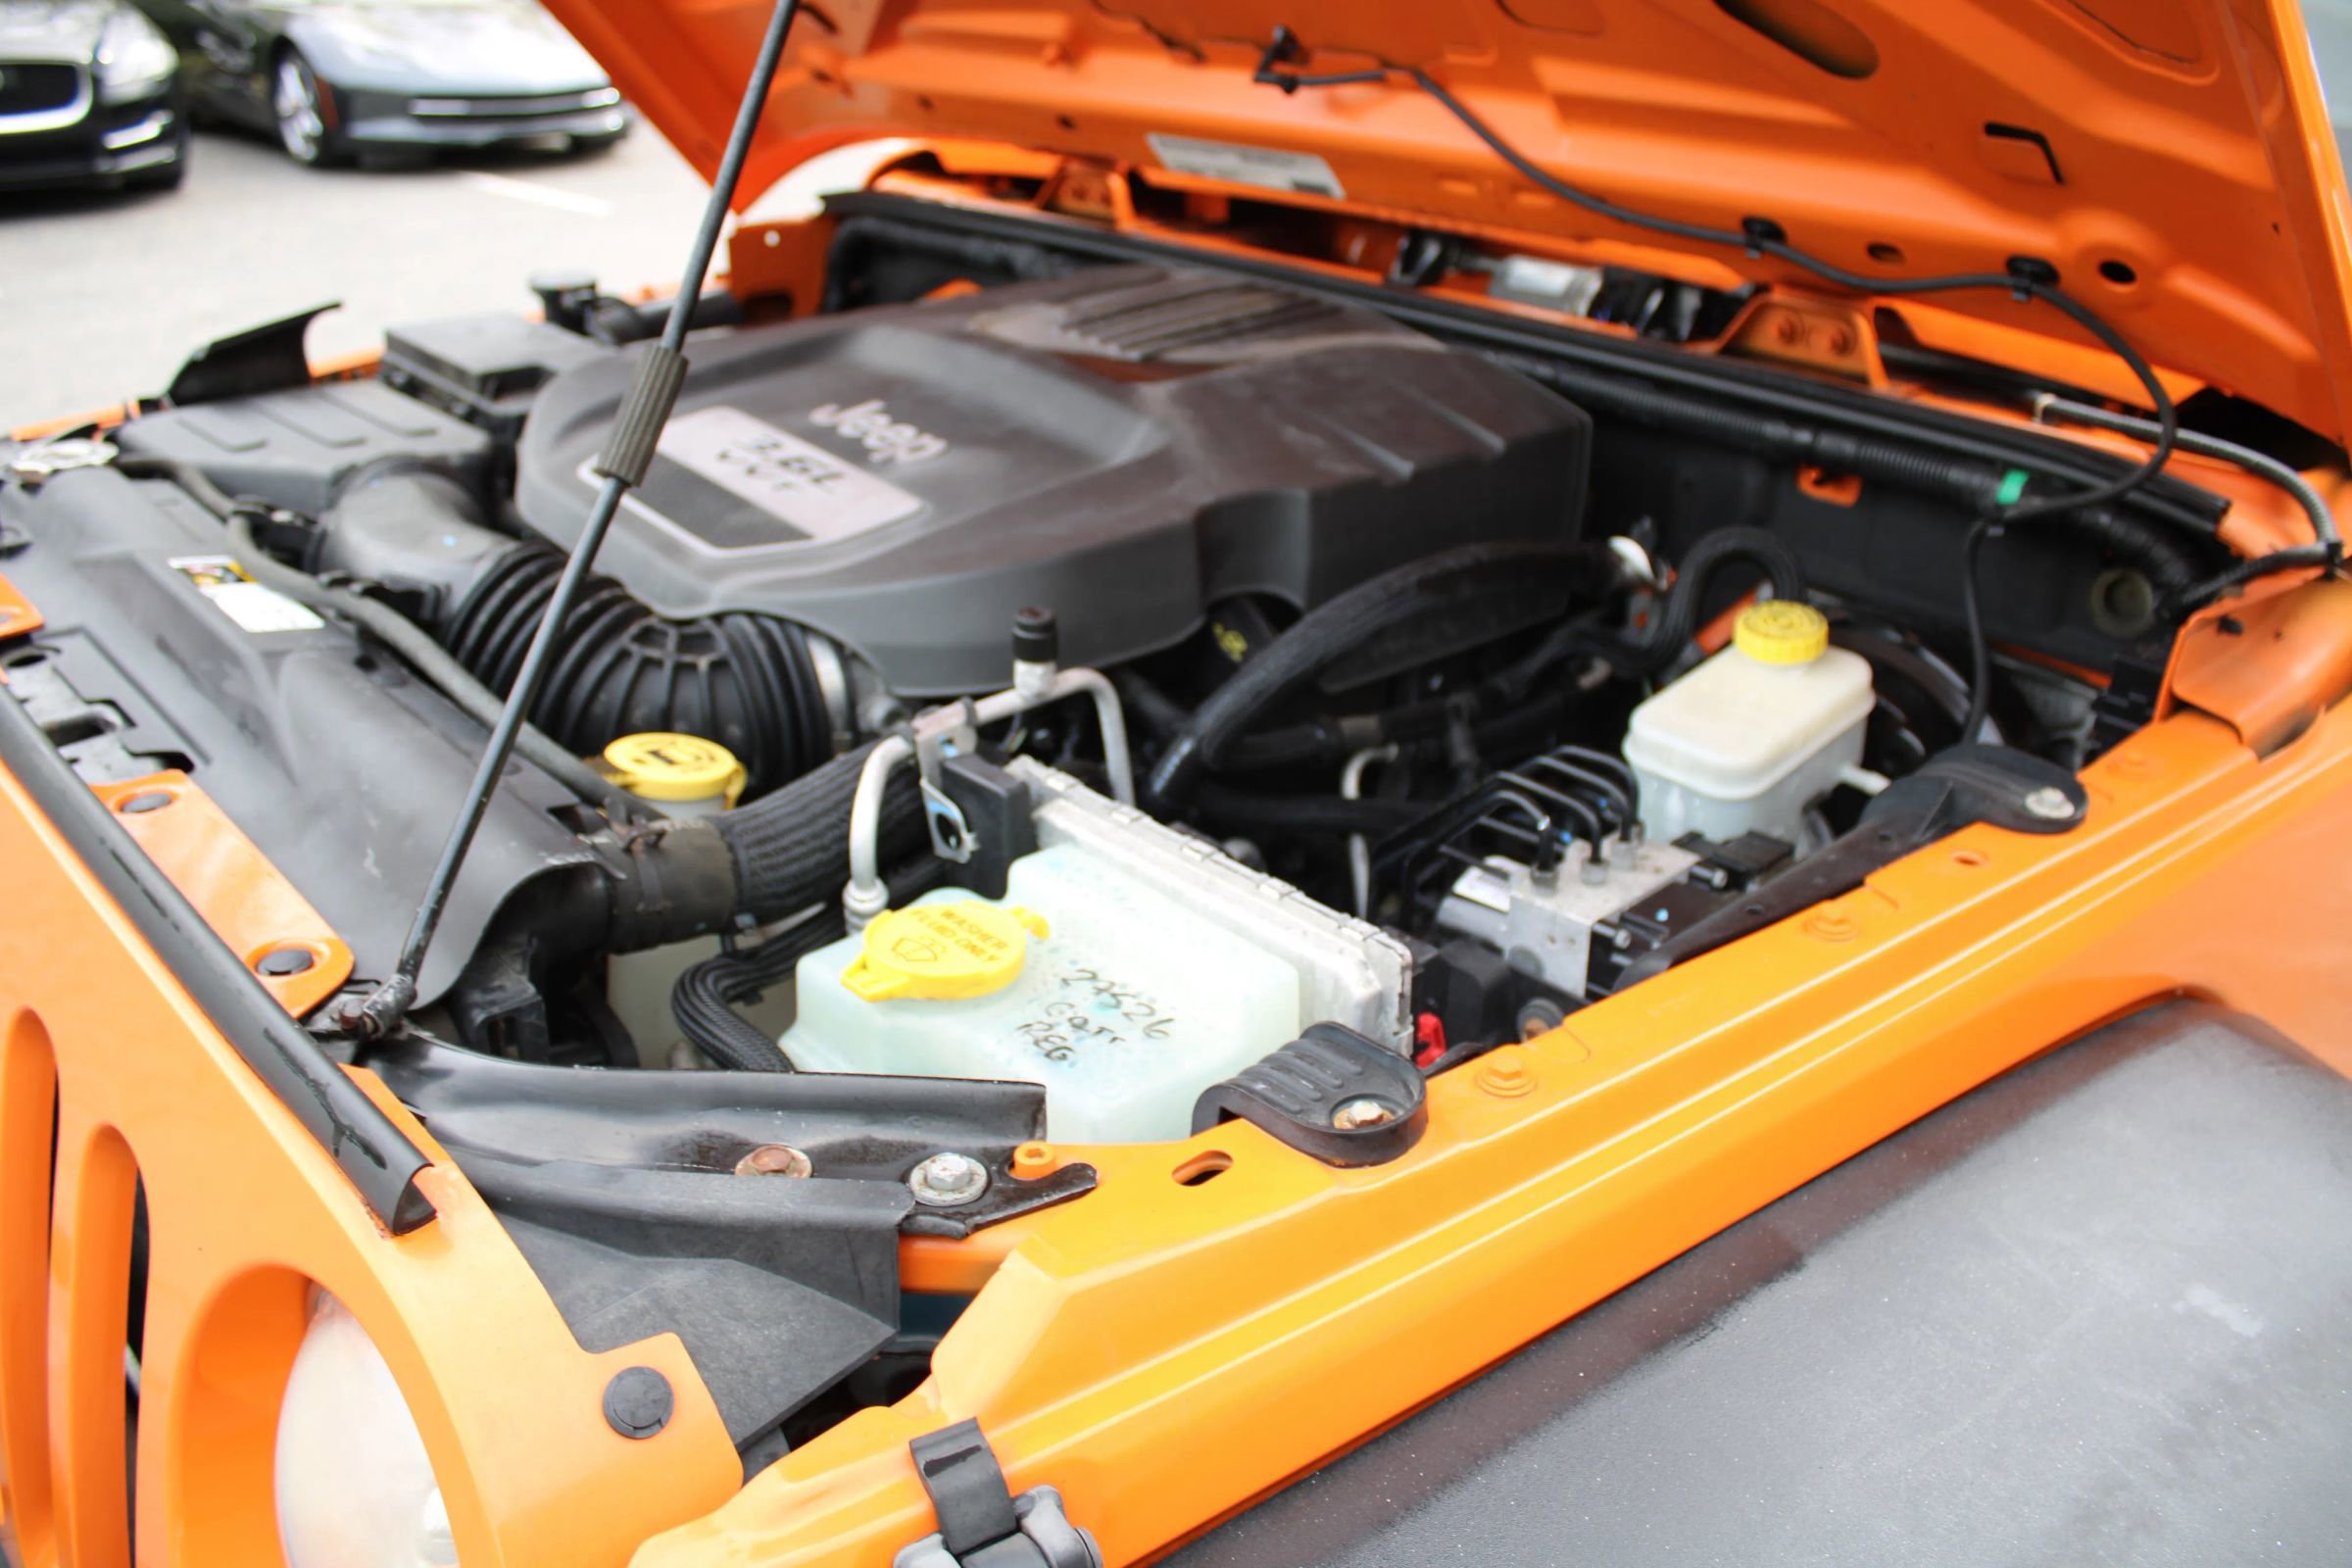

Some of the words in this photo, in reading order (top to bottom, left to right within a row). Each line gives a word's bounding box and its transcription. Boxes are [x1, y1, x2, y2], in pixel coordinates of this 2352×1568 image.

[808, 399, 947, 463] Jeep
[941, 908, 1008, 950] WASHER
[955, 938, 1000, 962] ONLY
